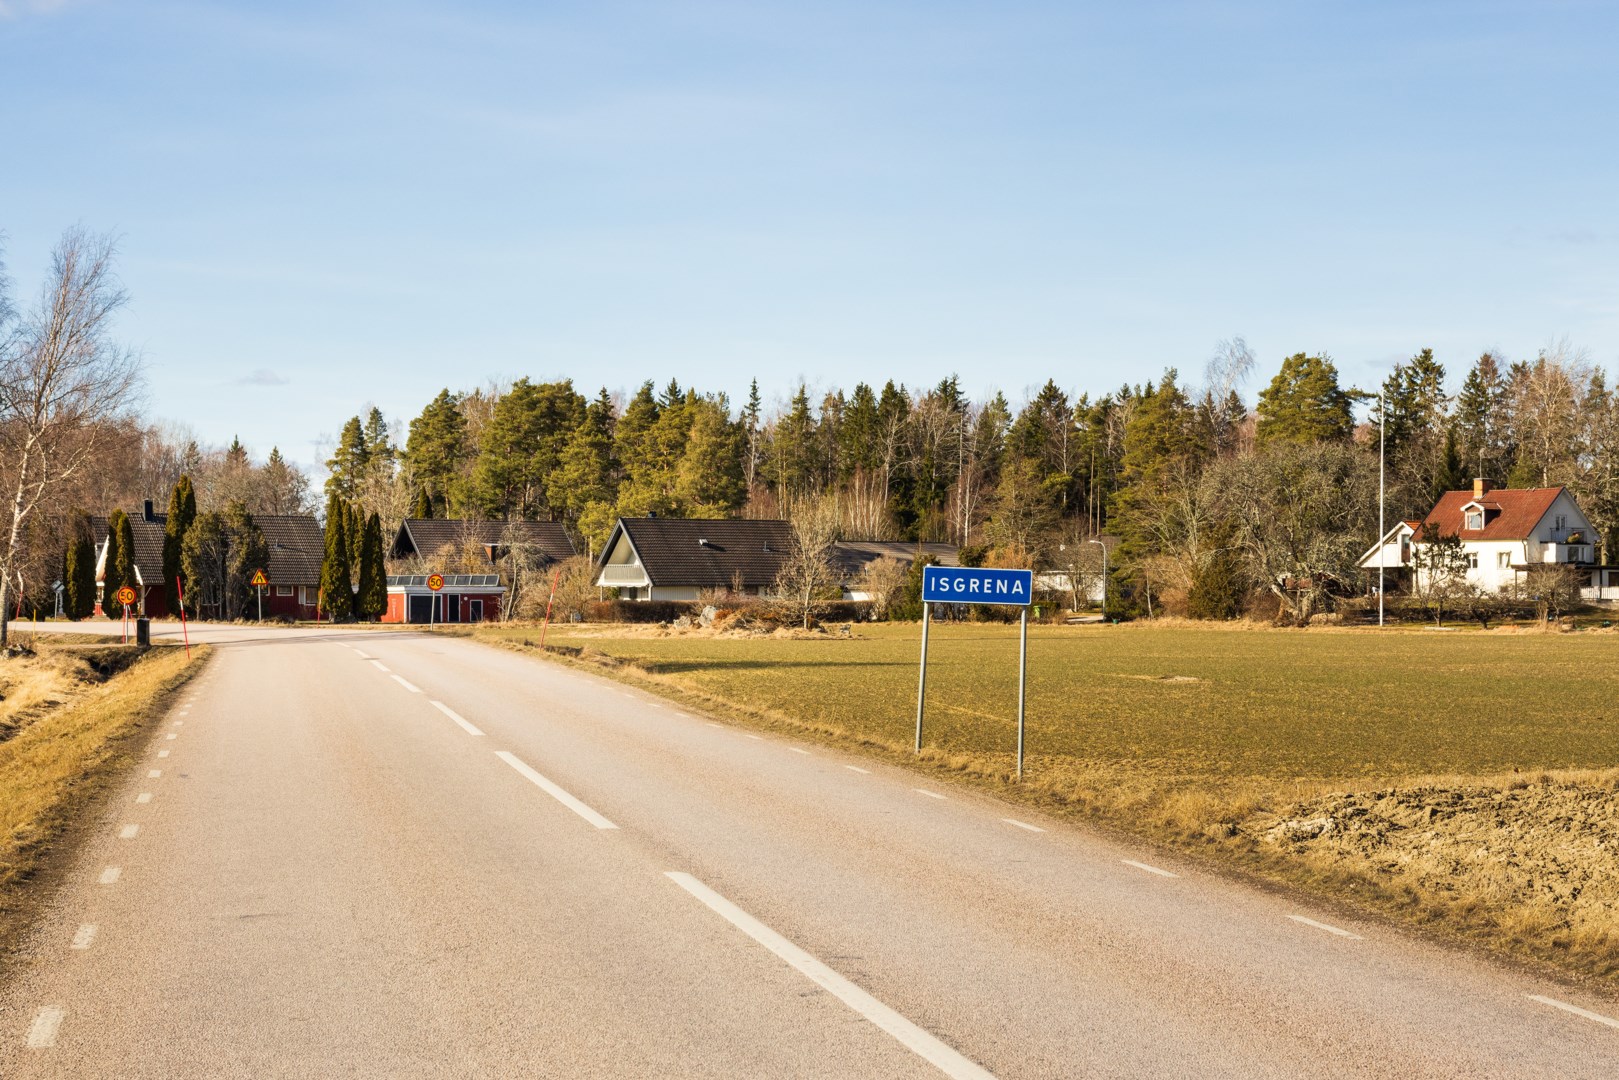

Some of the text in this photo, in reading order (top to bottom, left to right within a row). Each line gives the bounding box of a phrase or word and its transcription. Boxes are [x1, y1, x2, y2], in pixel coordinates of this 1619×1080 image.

[430, 578, 442, 586] 50
[931, 577, 1024, 594] ISGRENA
[120, 591, 132, 600] 50
